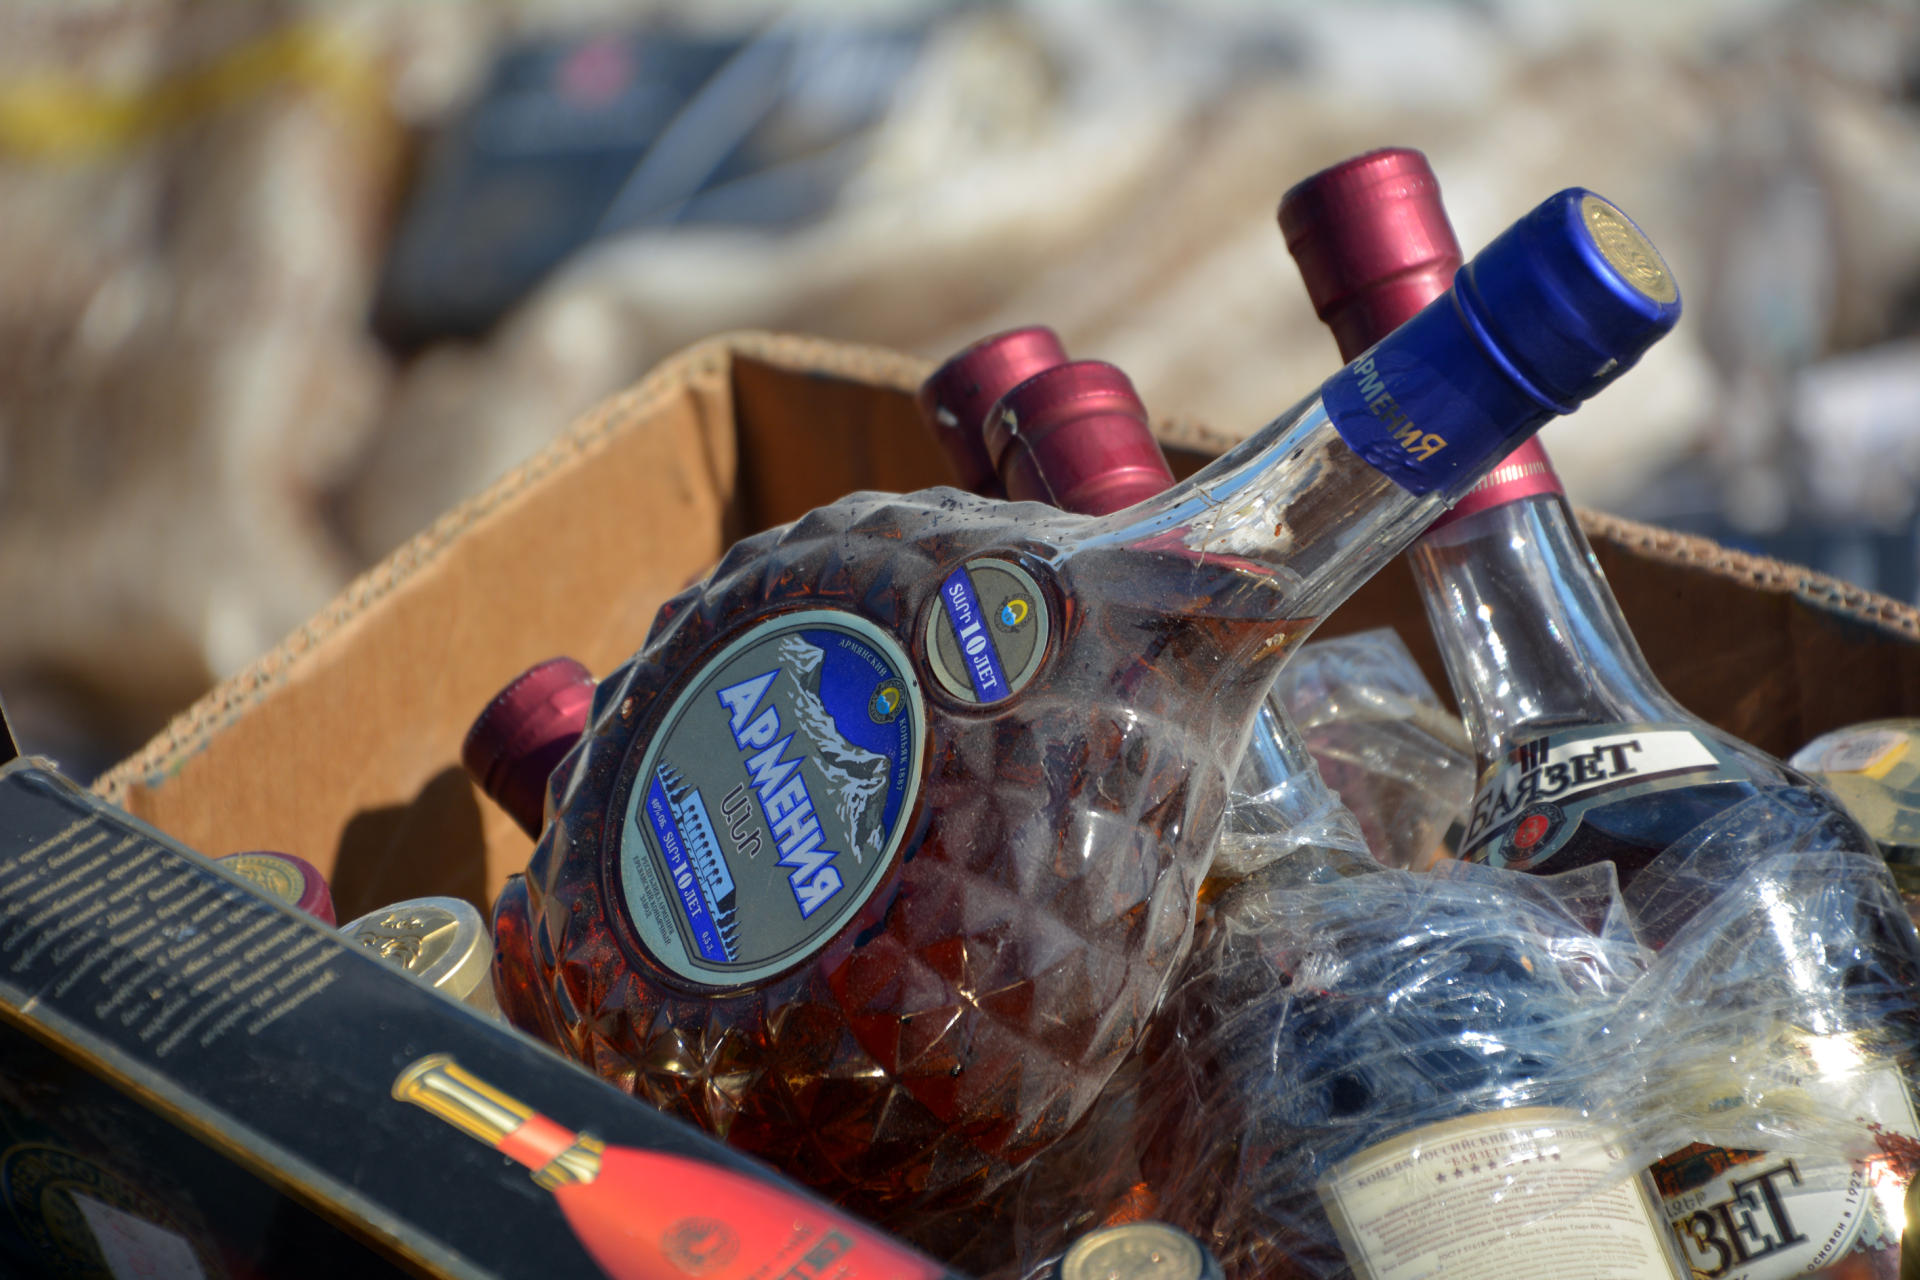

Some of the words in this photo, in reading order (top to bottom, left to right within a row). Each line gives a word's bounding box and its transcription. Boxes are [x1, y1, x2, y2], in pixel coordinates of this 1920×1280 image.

[1353, 347, 1448, 462] АРМЕНИЯ
[838, 639, 887, 677] АРМЯНСКИЙ
[960, 619, 987, 655] 10
[974, 655, 997, 690] ЛЕТ
[899, 716, 909, 765] КОНЬЯК
[716, 668, 844, 920] АРМЕНИЯ
[1466, 740, 1643, 843] БАЯЗЕТ
[673, 860, 693, 890] 10
[684, 889, 702, 917] ЛЕТ
[1672, 1157, 1810, 1279] ЗЕТ
